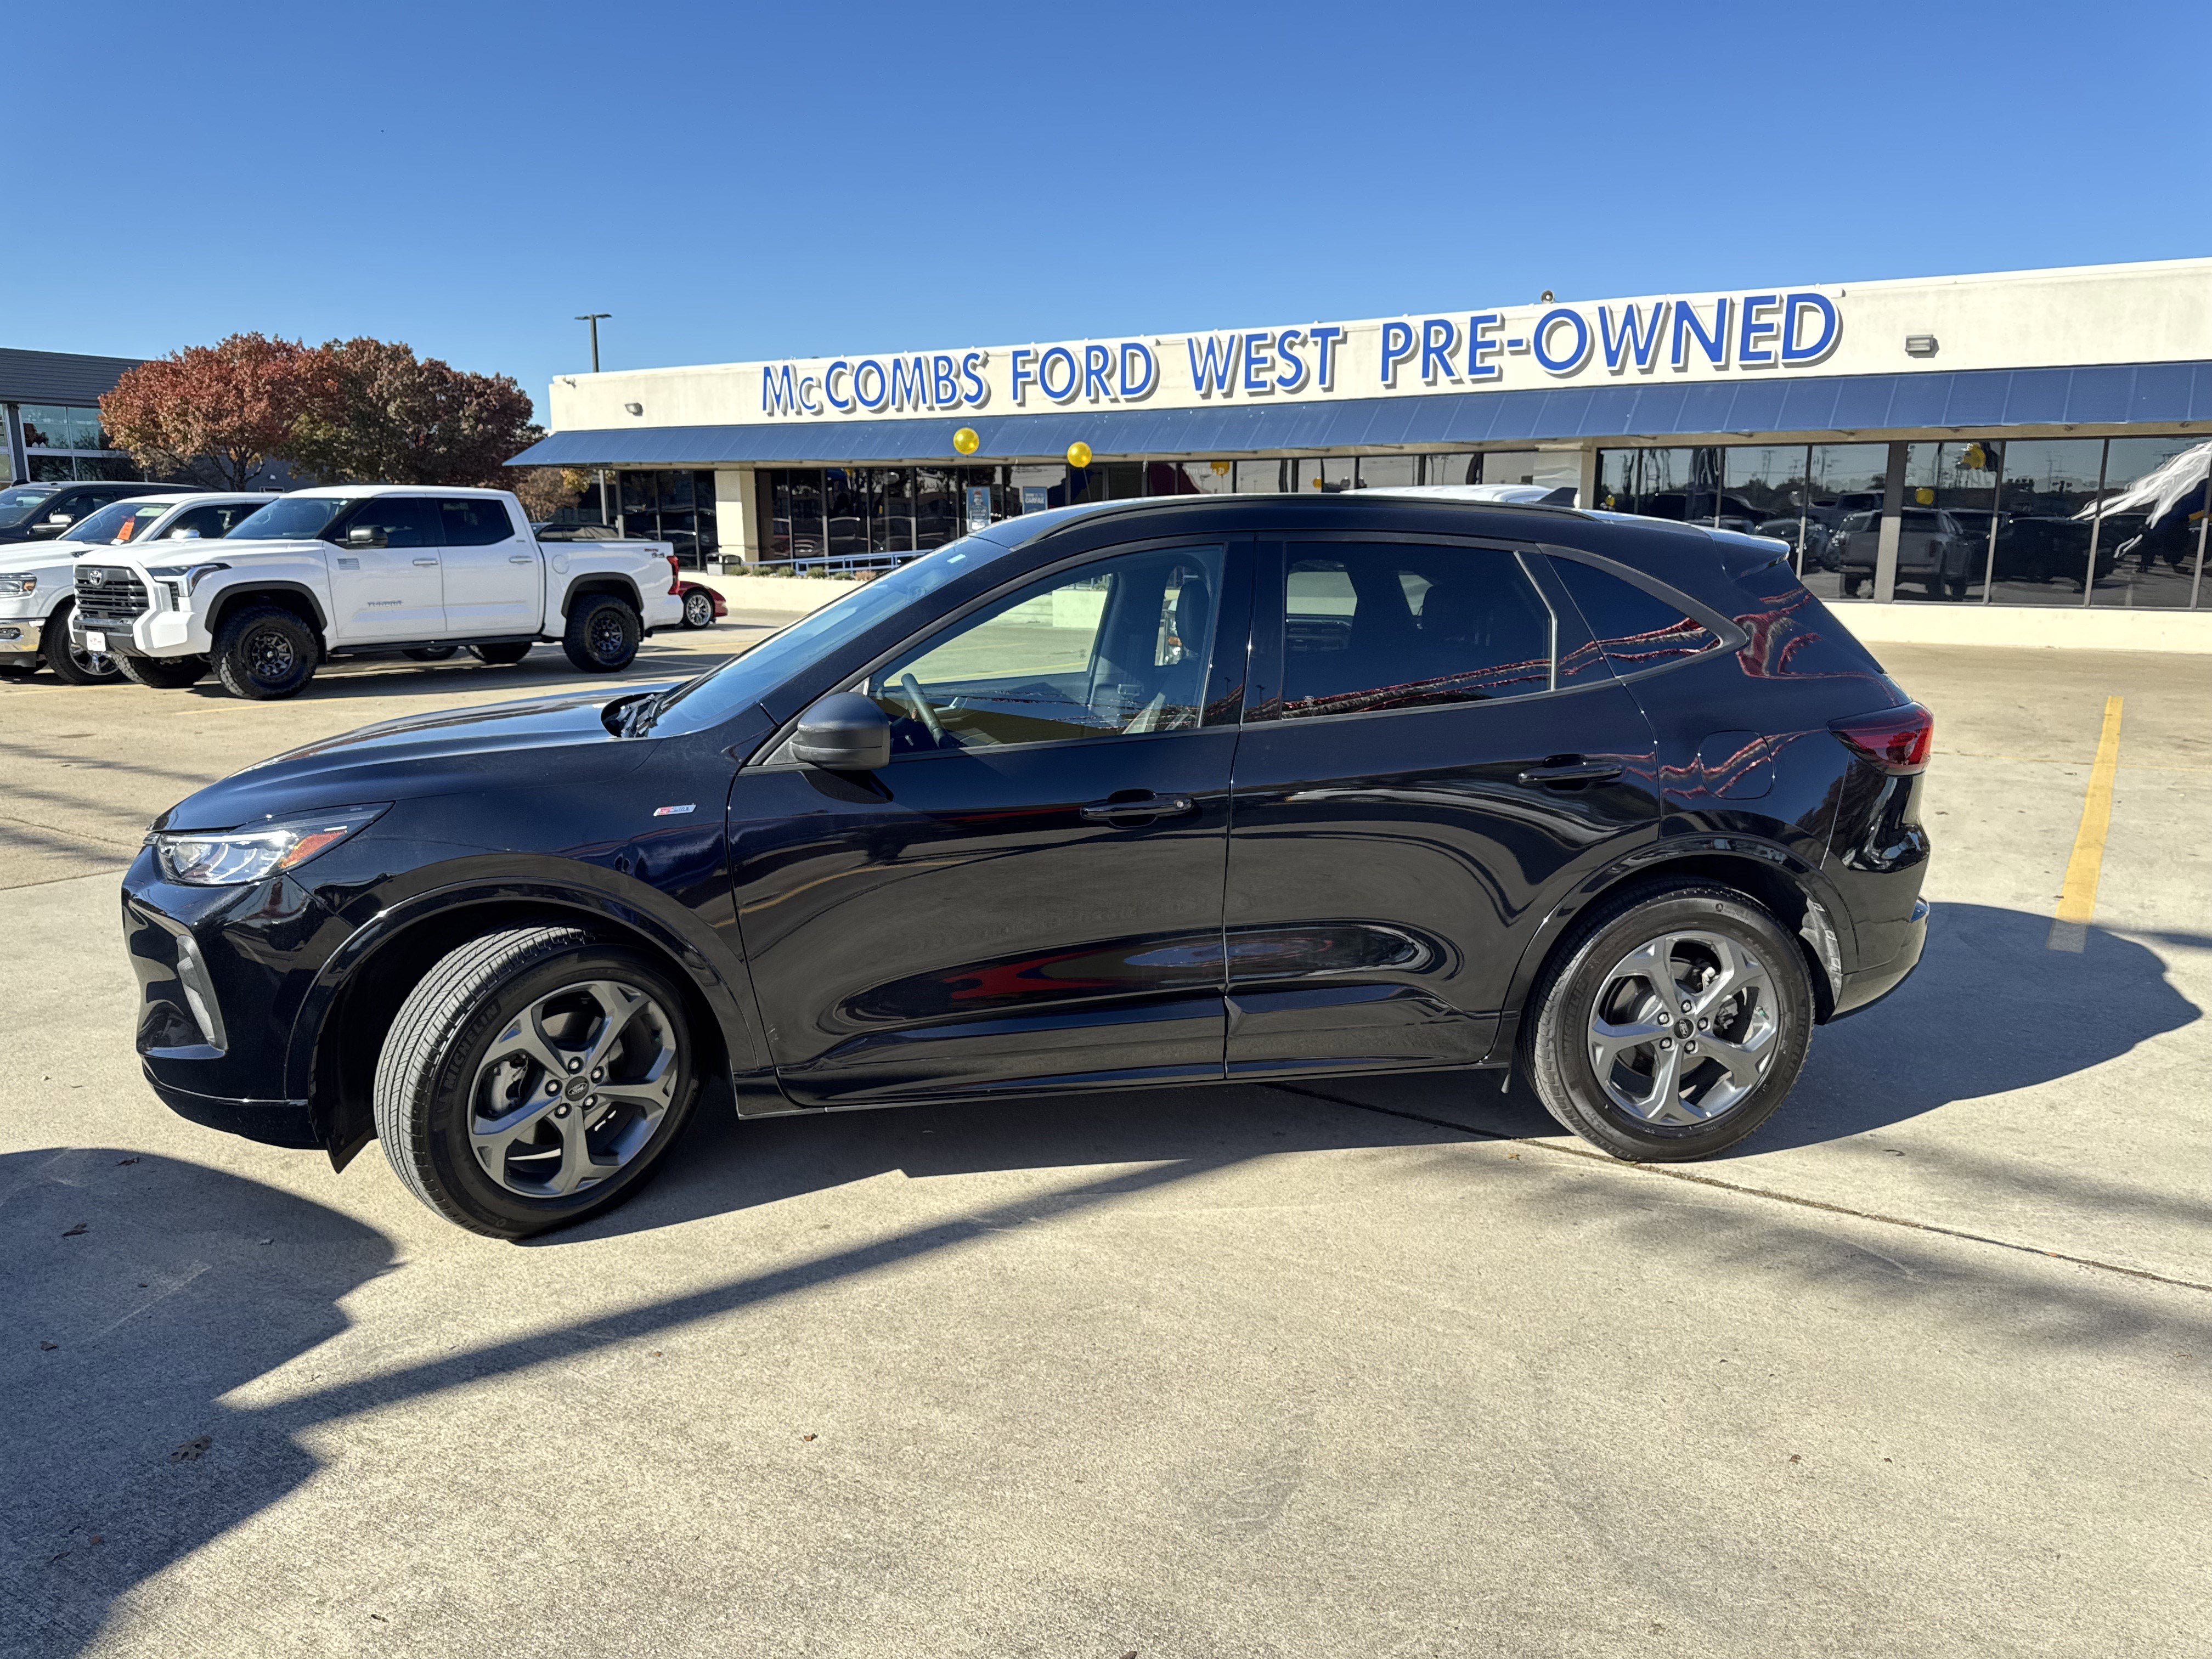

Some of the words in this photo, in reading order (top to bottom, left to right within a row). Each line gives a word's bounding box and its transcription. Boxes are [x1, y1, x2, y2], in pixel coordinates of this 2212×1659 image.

[763, 353, 986, 413] McCOMBS
[1012, 342, 1154, 400] FORD
[1187, 326, 1341, 392] WEST
[1381, 292, 1838, 382] PRE-OWNED
[444, 1002, 500, 1091] MICHELIN
